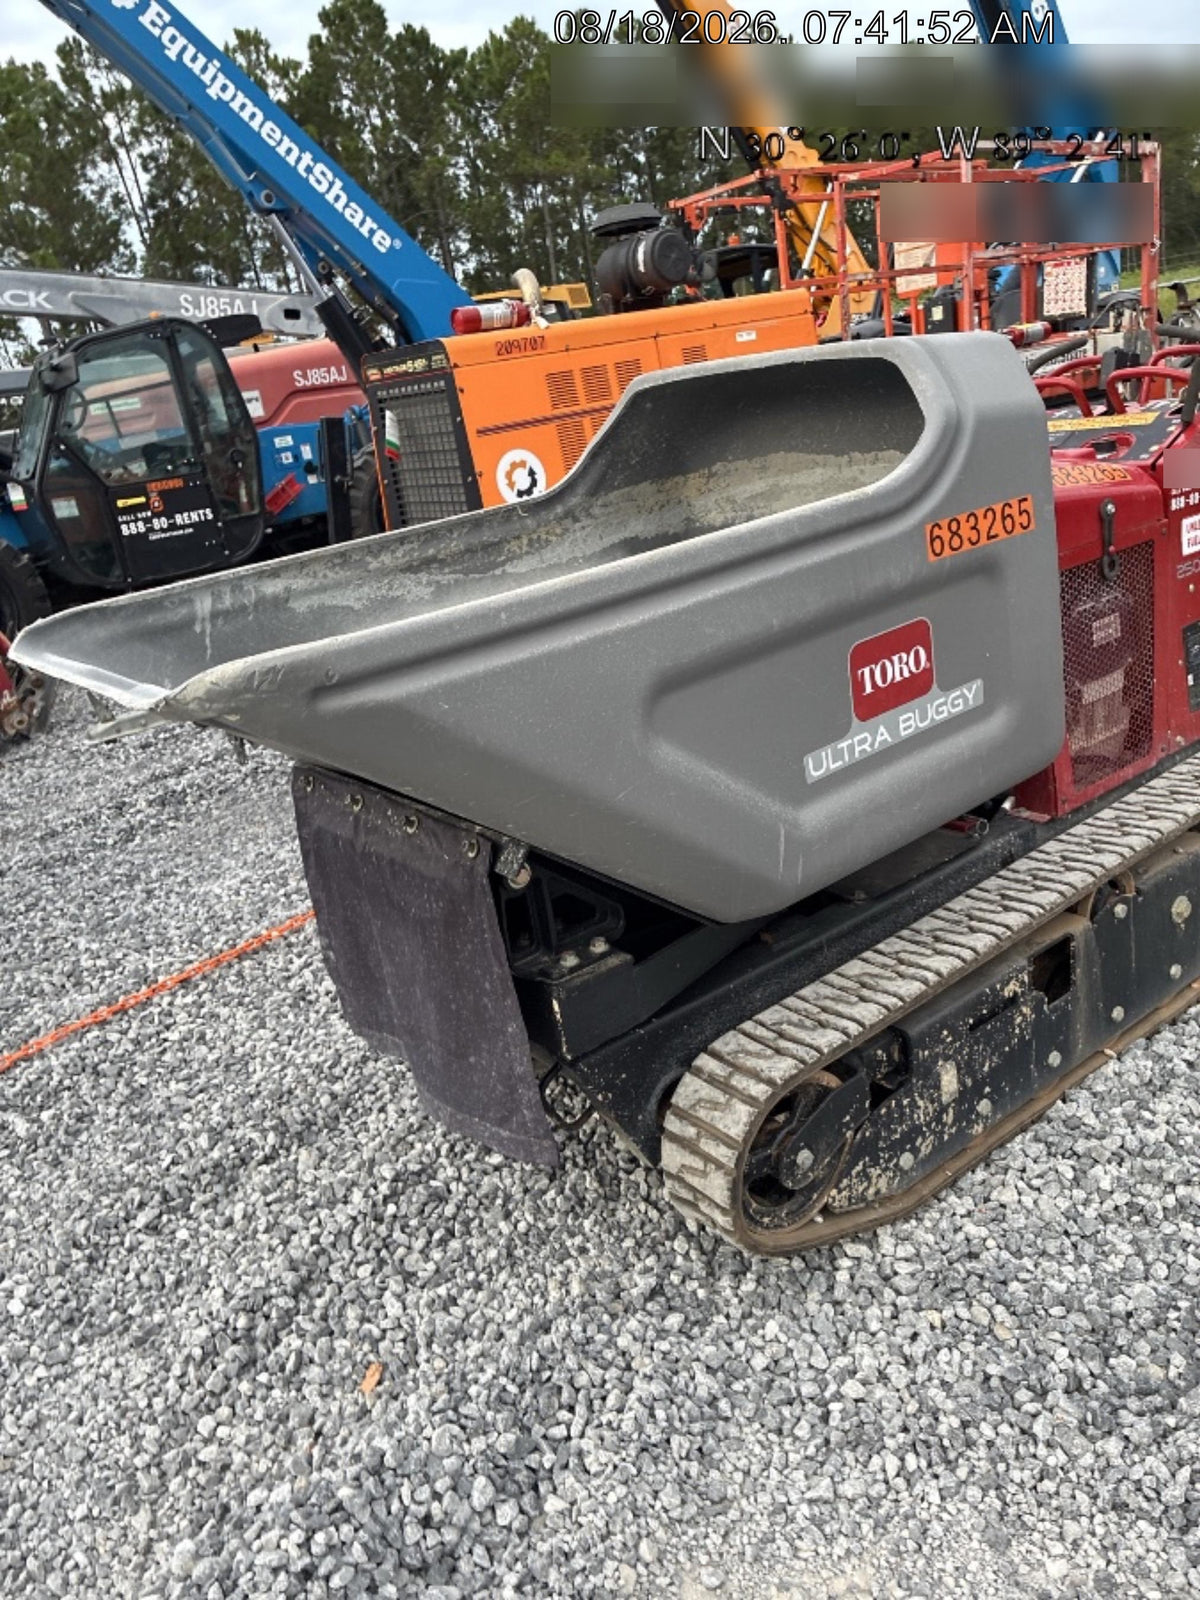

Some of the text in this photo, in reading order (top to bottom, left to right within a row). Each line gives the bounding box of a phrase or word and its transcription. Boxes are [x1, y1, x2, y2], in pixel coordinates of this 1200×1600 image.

[293, 365, 348, 388] SJ85AJ
[929, 497, 1032, 557] 683265
[857, 645, 928, 696] TORO
[807, 683, 978, 777] ULTRA BUGGY
